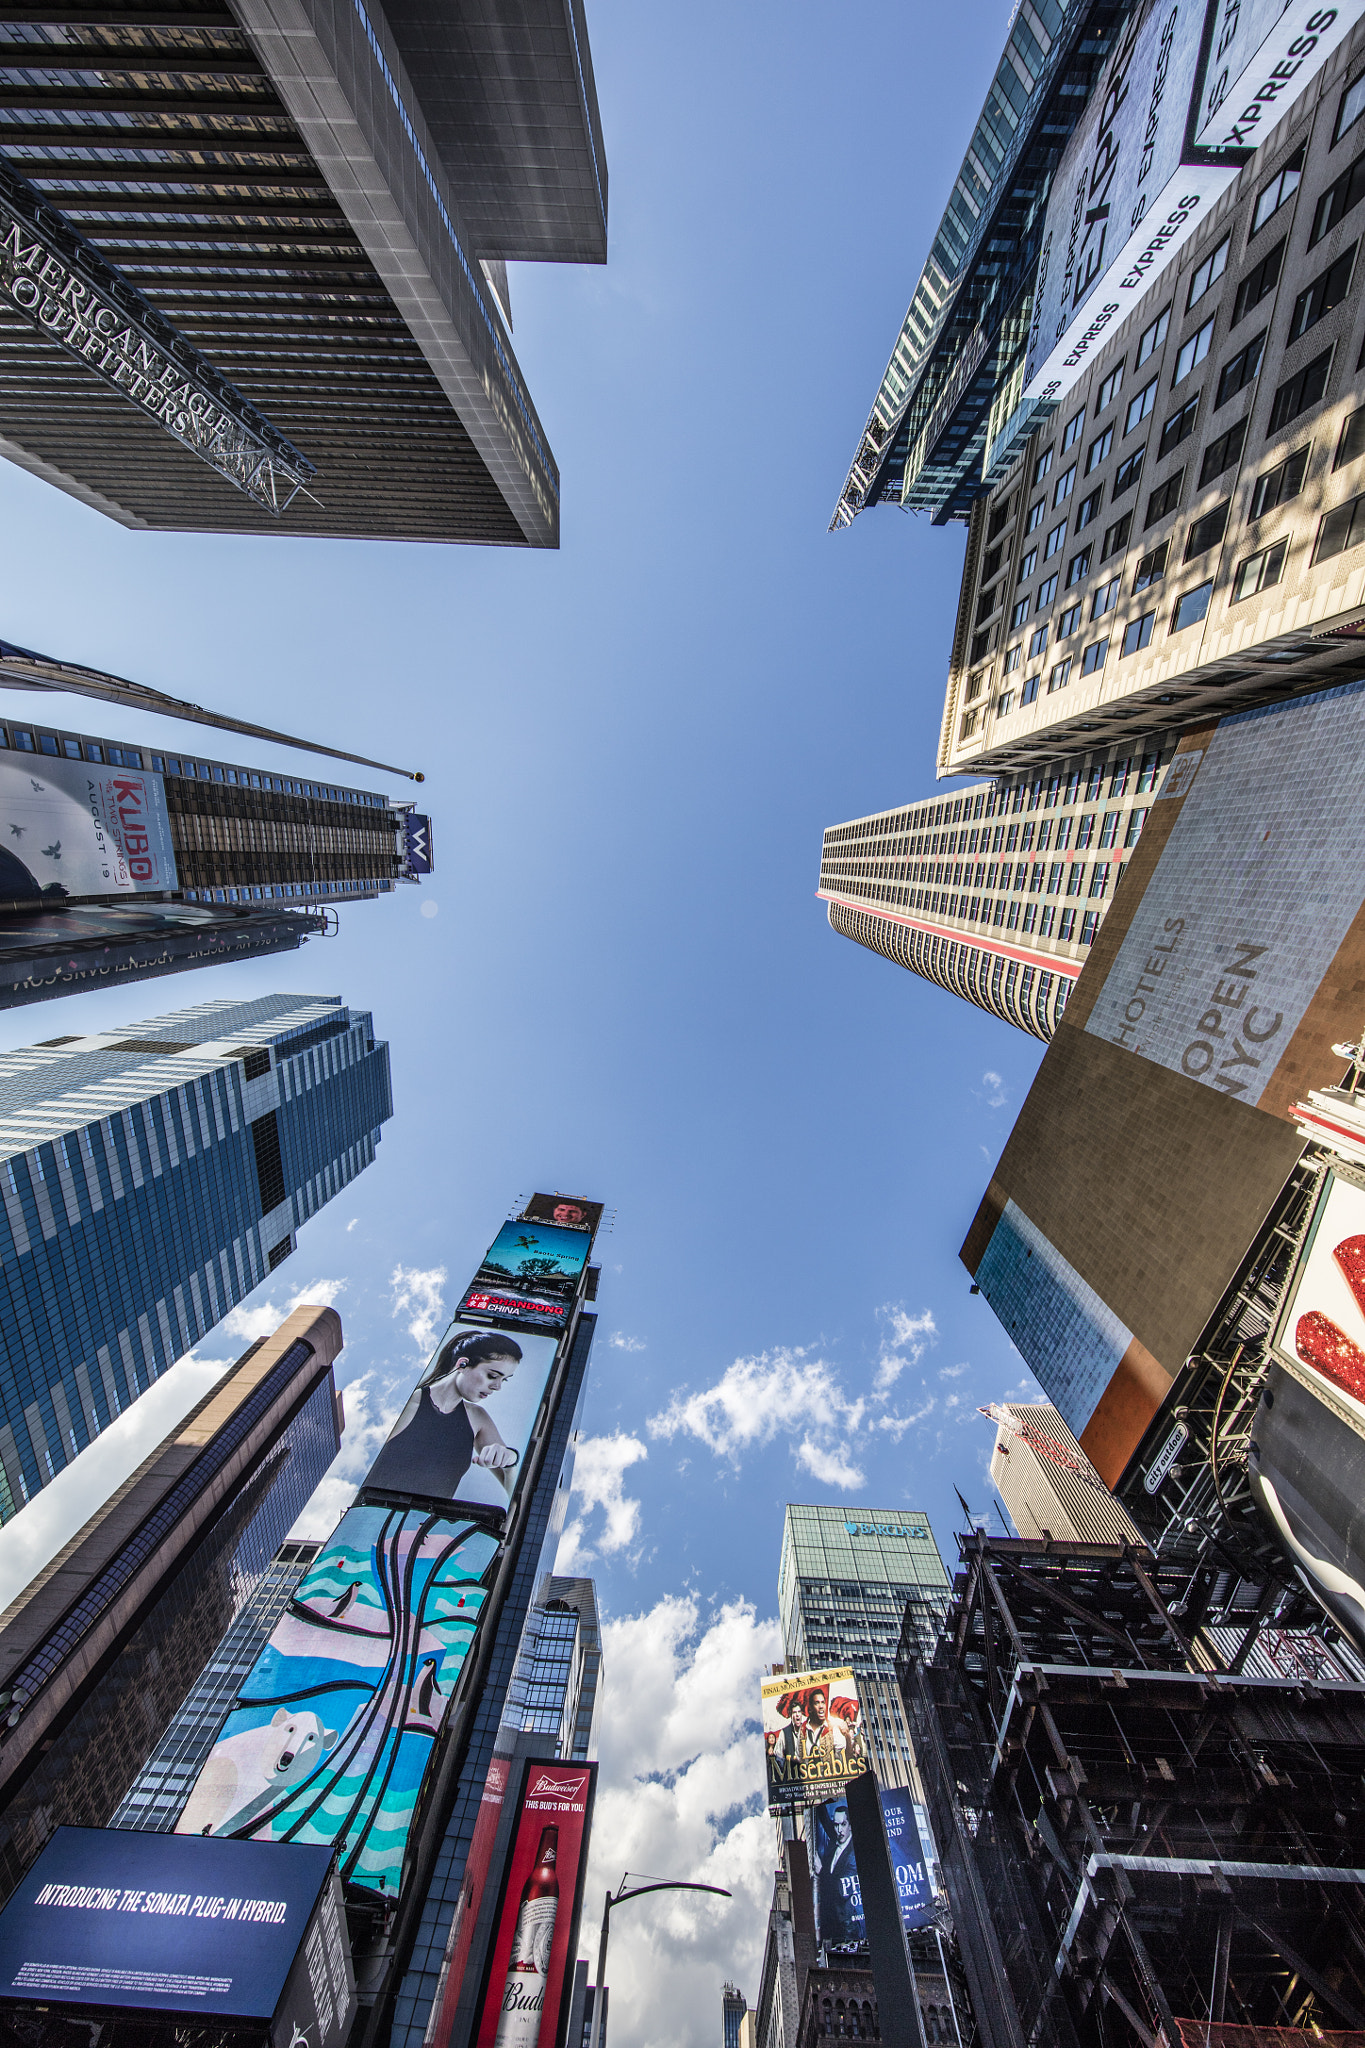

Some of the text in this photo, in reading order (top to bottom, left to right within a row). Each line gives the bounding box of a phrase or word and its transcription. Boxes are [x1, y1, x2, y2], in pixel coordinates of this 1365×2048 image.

[1221, 8, 1339, 145] XPRESS
[1063, 303, 1120, 367] EXPRESS
[1119, 195, 1201, 288] EXPRESS
[12, 276, 193, 433] OUTFITTERS
[157, 363, 232, 437] EAGLE
[87, 780, 110, 878] AUGUST 19
[107, 795, 118, 825] TWO
[113, 828, 128, 879] STRINGS
[113, 780, 153, 881] KUBO
[411, 826, 427, 861] W
[1111, 917, 1186, 1047] HOTELS
[1181, 942, 1270, 1077] OPEN
[556, 1253, 580, 1262] Spring
[487, 1303, 520, 1315] CHINA
[491, 1296, 564, 1315] SHANDONG
[1149, 1429, 1183, 1486] city outdoor
[860, 1523, 925, 1538] BARCLAYS
[768, 1748, 867, 1783] Misérables
[800, 1739, 827, 1760] Les
[525, 1800, 585, 1812] THIS BUD'S FOR YOU.
[536, 1780, 578, 1793] Budweiser
[35, 1883, 287, 1924] INTRODUCING THE SONATA PLUG-IN HYBRID.
